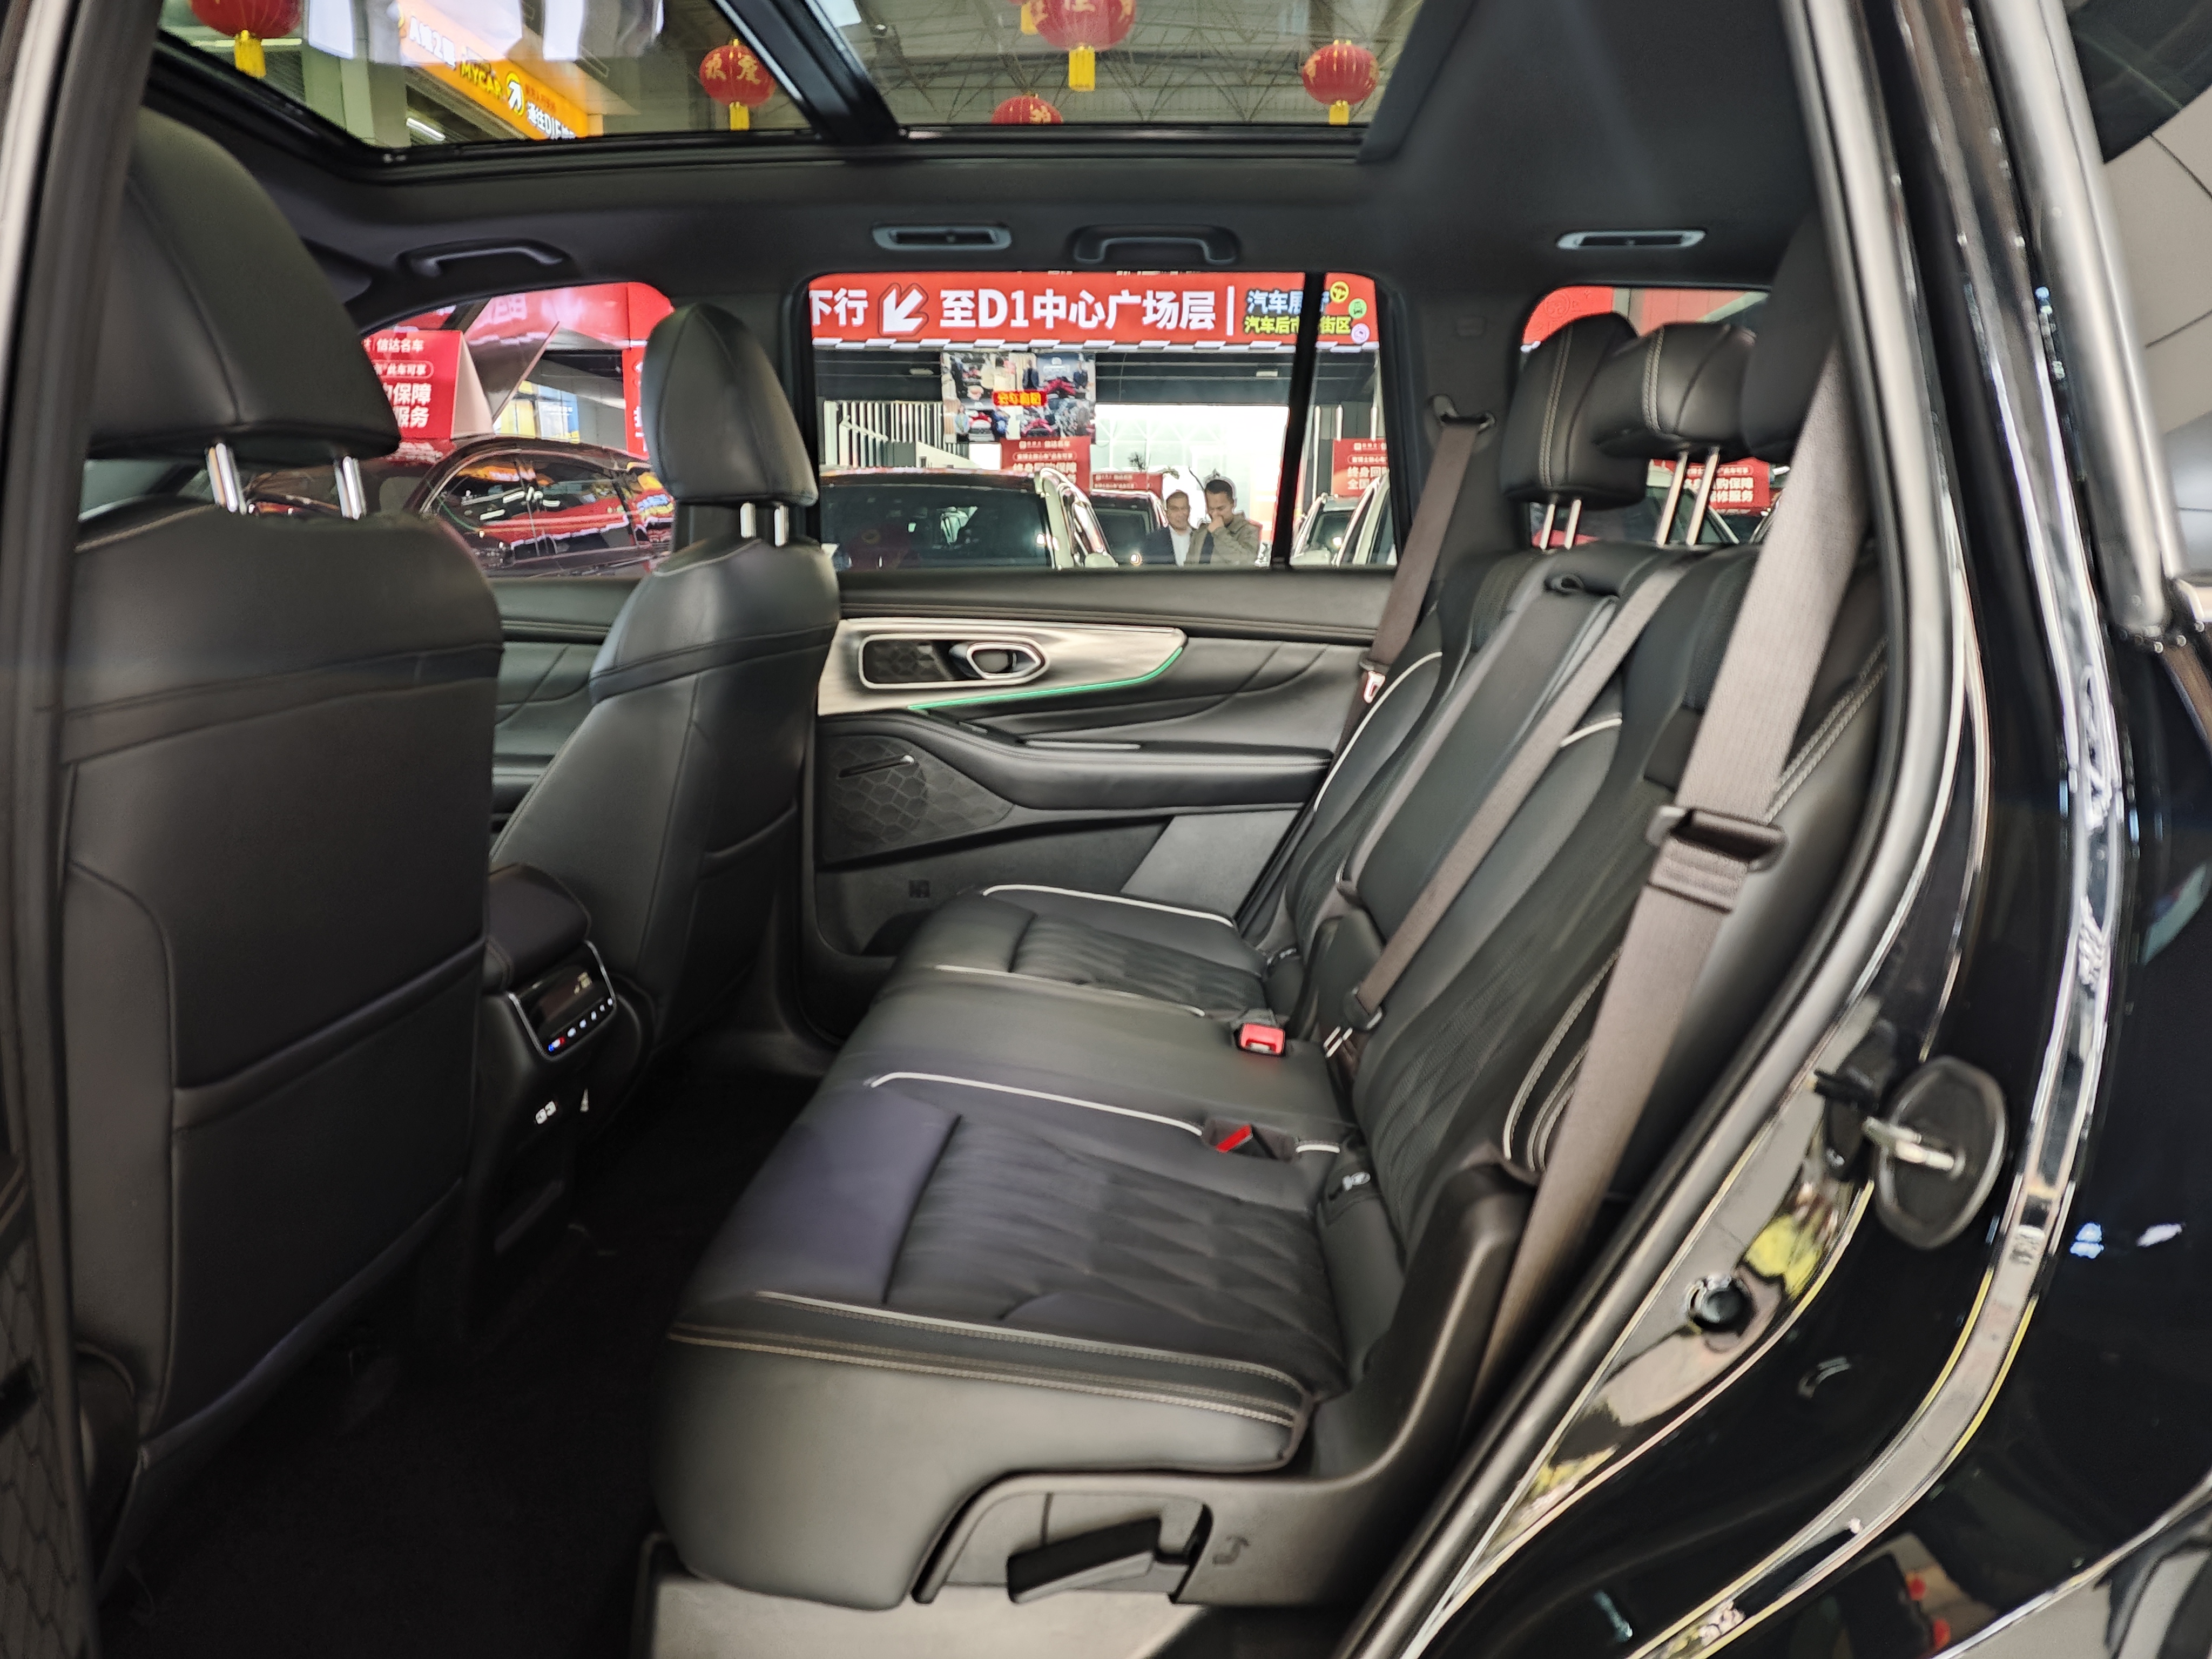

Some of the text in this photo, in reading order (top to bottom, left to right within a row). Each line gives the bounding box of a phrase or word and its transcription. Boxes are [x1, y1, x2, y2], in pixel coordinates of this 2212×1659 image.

[809, 288, 1216, 331] 下行 至D1中心广场层
[1244, 315, 1352, 334] 汽车后市街区
[376, 339, 424, 353] 信达名车
